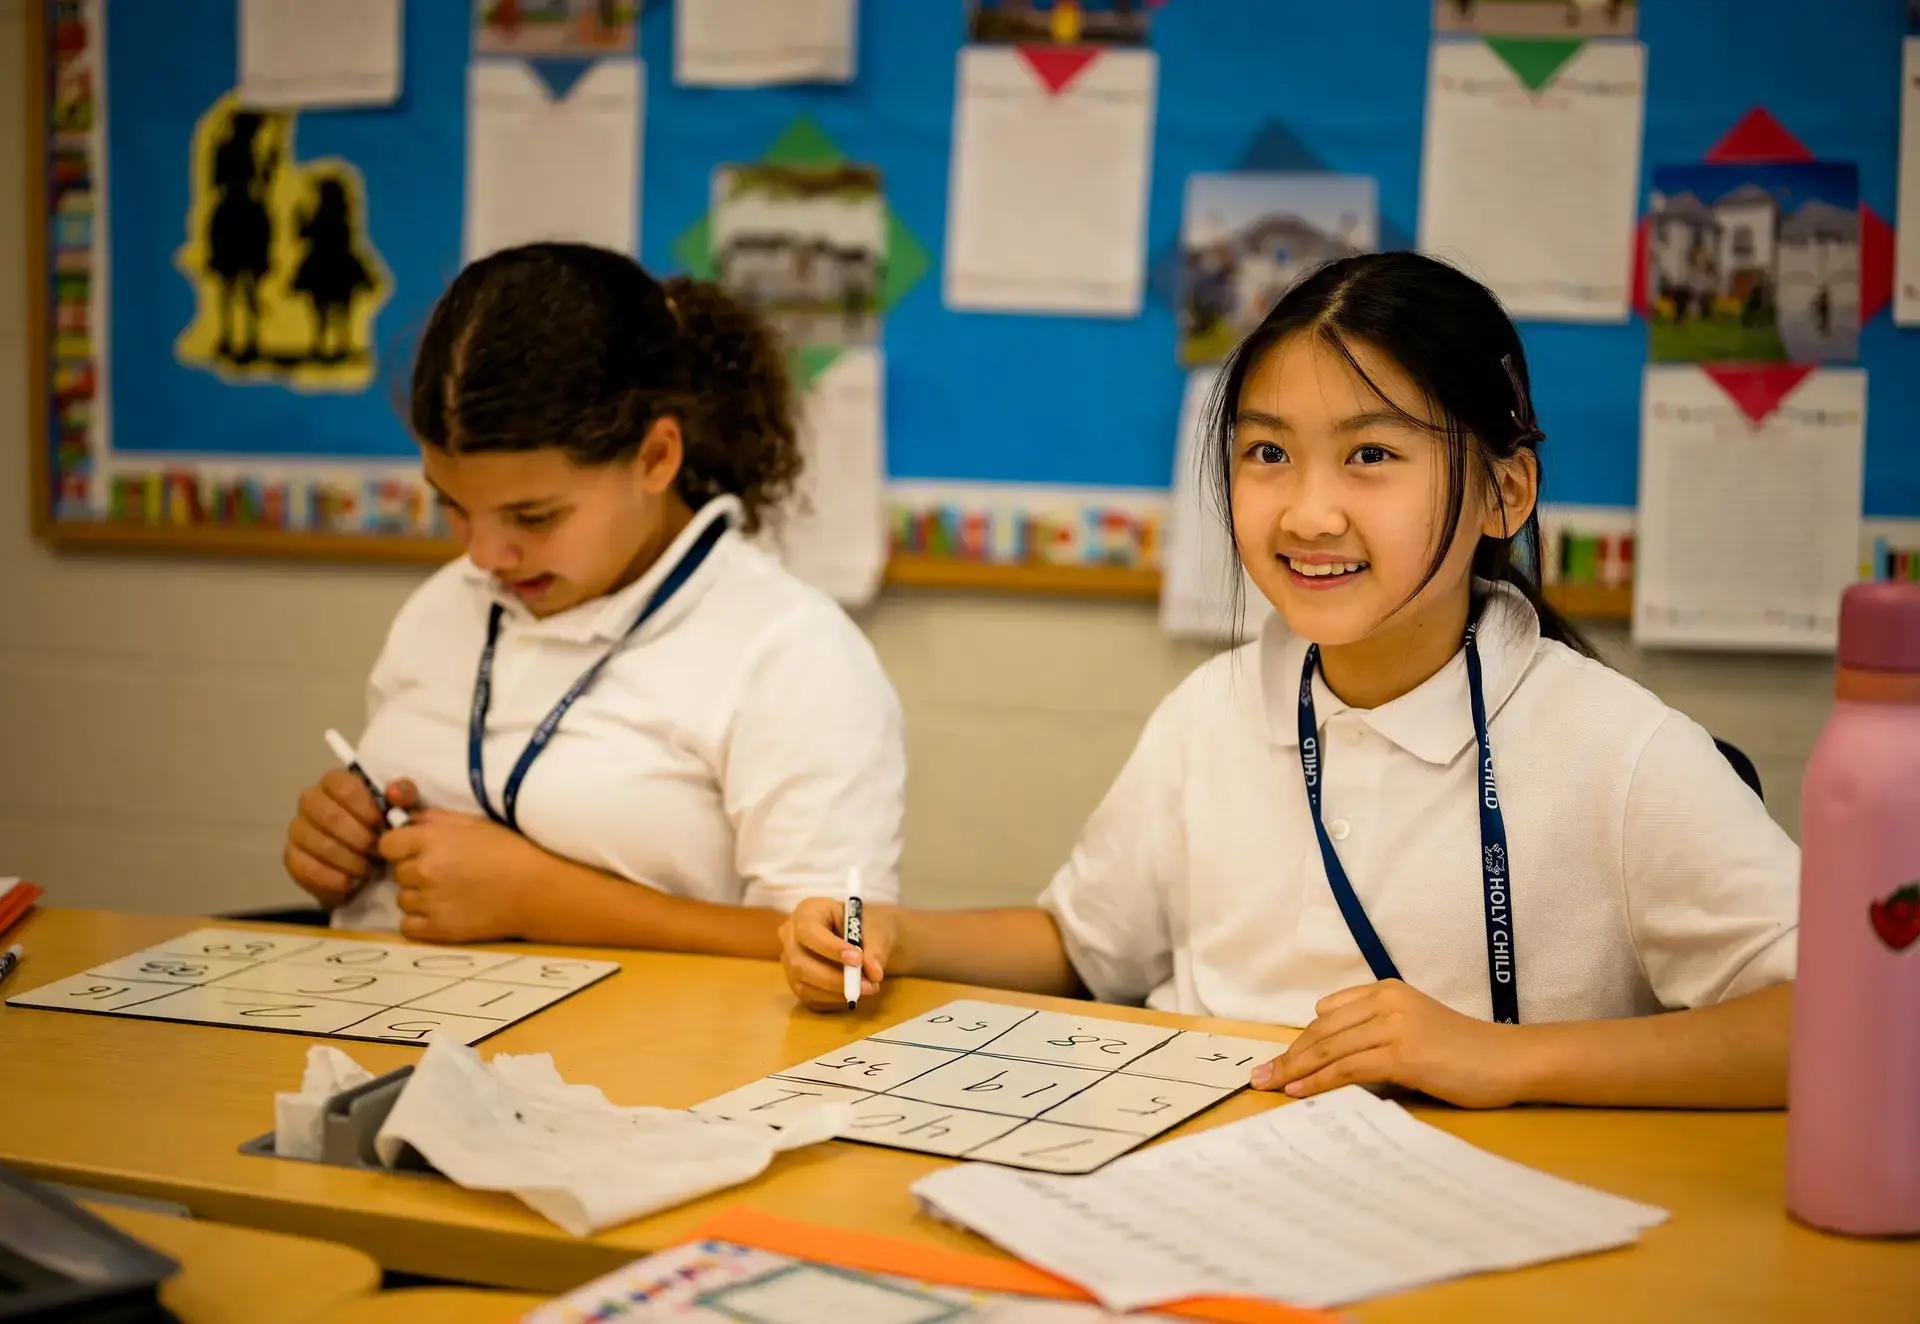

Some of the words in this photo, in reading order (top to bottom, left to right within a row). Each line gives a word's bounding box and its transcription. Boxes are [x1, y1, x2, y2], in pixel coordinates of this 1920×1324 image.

[1304, 737, 1317, 786] CHILD
[1485, 757, 1498, 809] CHILD
[1489, 878, 1508, 926] HOLY
[848, 917, 862, 943] EXPO
[1492, 929, 1511, 984] CHILD
[69, 985, 131, 1000] 16
[297, 973, 377, 994] 6
[378, 1021, 441, 1039] 5
[1046, 1035, 1128, 1055] 28
[815, 1056, 891, 1077] 35
[1195, 1053, 1254, 1067] 15
